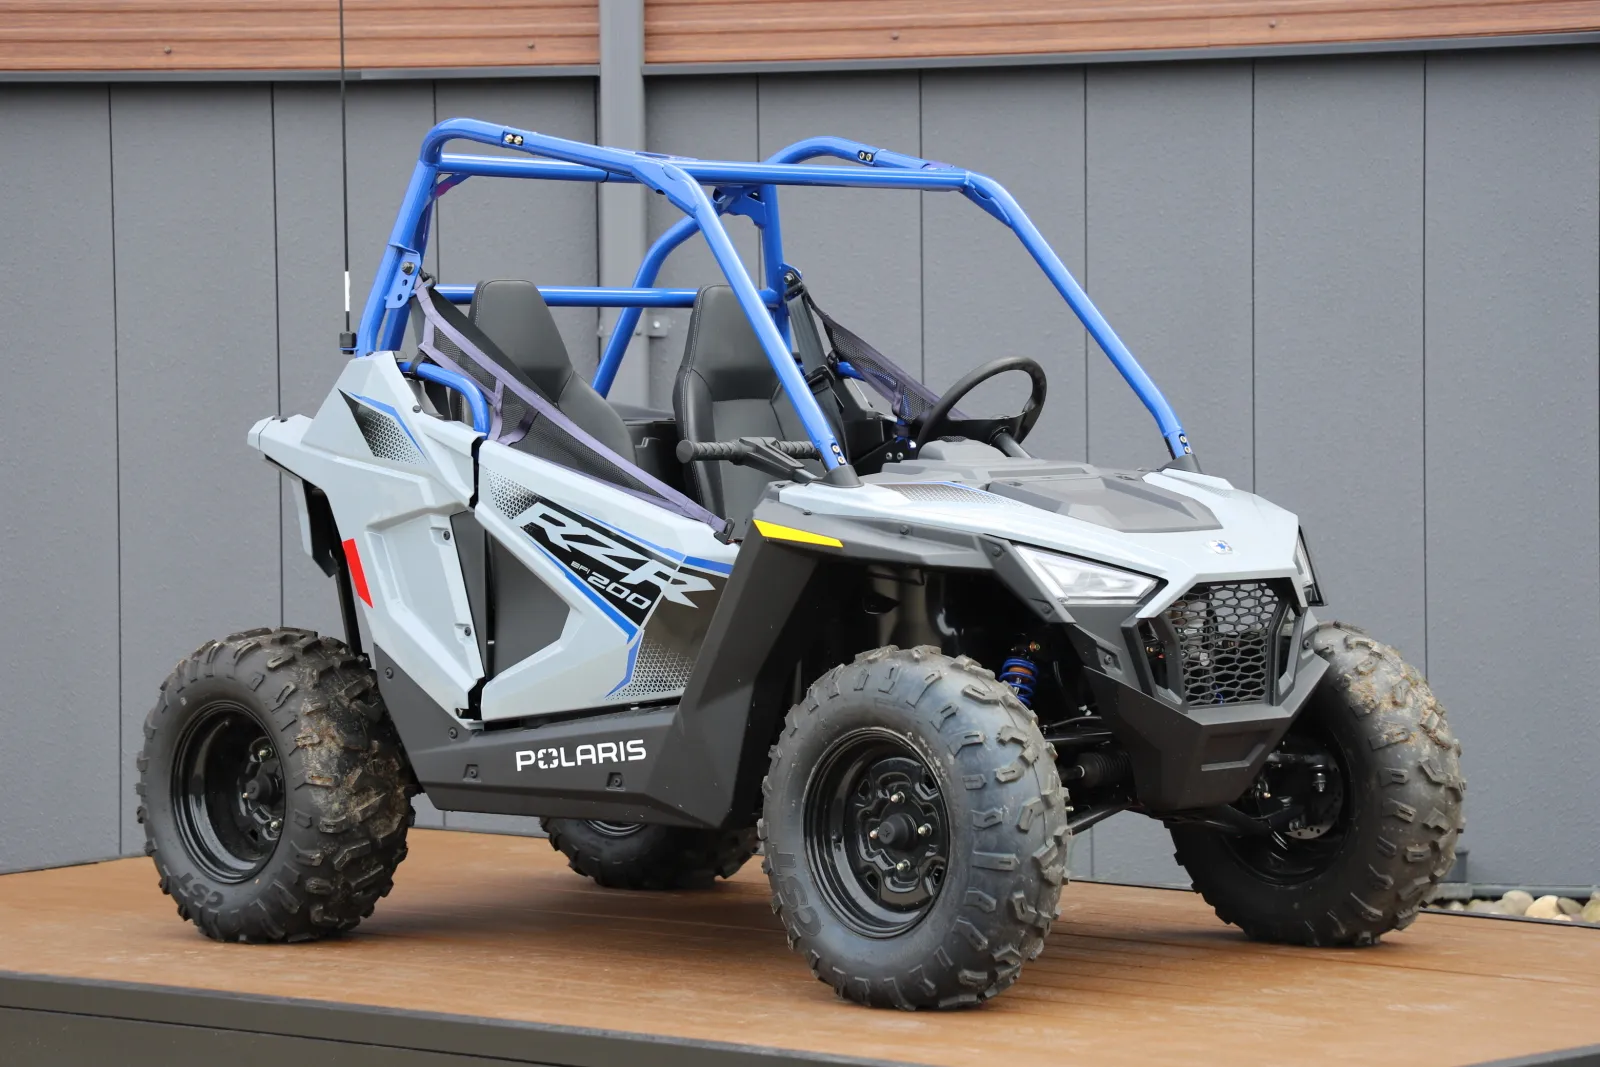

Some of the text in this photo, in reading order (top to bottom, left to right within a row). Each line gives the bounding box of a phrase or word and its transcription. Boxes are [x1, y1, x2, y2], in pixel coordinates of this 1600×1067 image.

[515, 502, 715, 608] RZR
[570, 561, 652, 610] EFI 200
[516, 739, 647, 772] POLARIS
[171, 873, 224, 909] CST
[772, 843, 822, 937] CST
